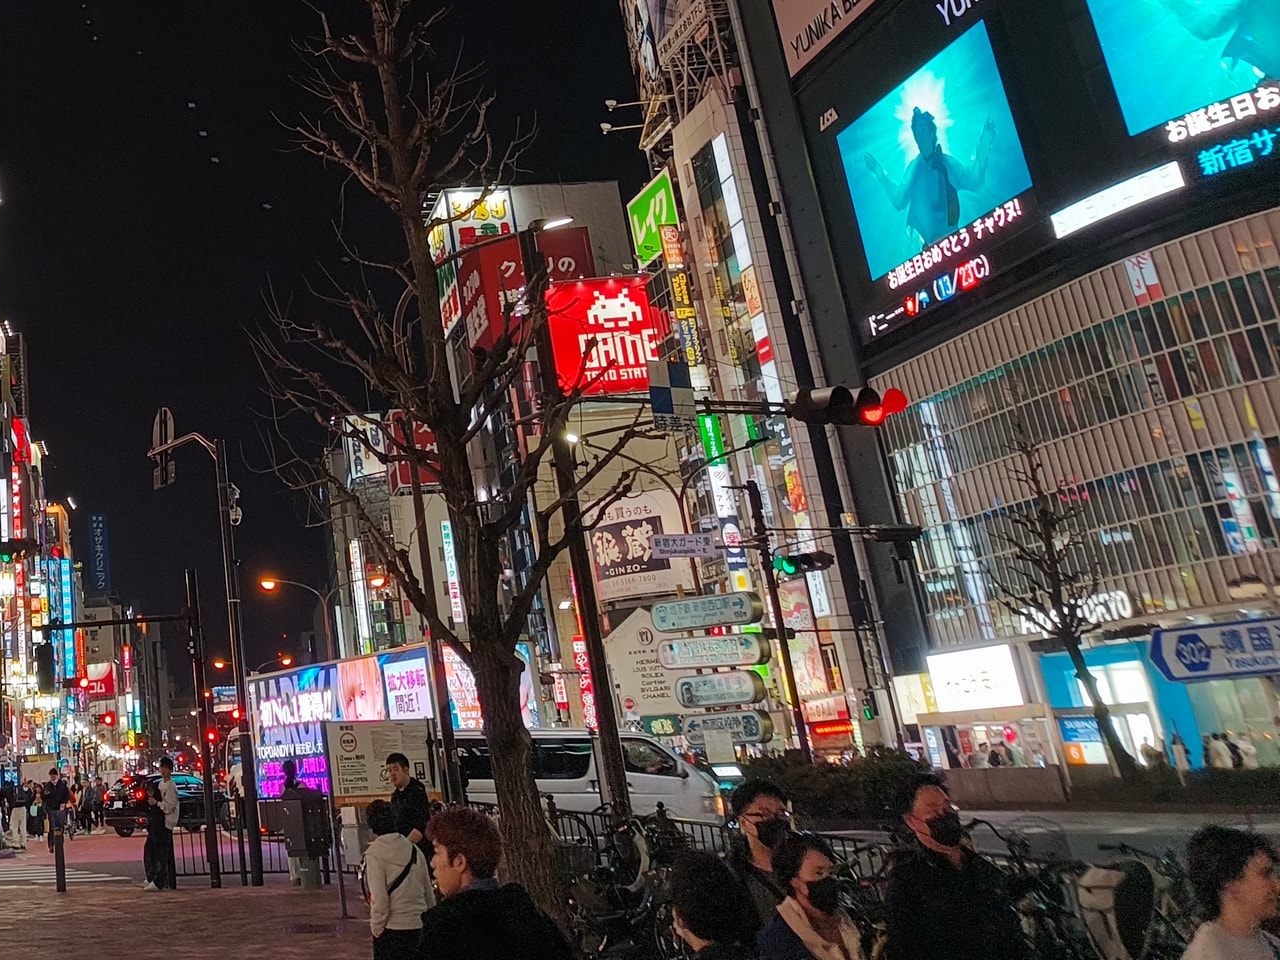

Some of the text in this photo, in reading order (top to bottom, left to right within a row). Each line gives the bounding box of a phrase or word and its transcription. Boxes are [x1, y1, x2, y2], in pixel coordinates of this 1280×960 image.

[790, 1, 842, 60] YUNIKA
[633, 188, 667, 246] レイク
[887, 198, 1023, 290] お誕生日おめでとう チャウヌ!
[578, 327, 660, 369] GAME
[655, 416, 697, 434] 時差式
[654, 537, 711, 548] 新宿大ガード東
[93, 528, 105, 590] オザキクリニック
[1180, 642, 1210, 665] 302
[88, 681, 106, 694] コム
[386, 667, 426, 692] 拡大移転
[394, 692, 421, 715] 間近!
